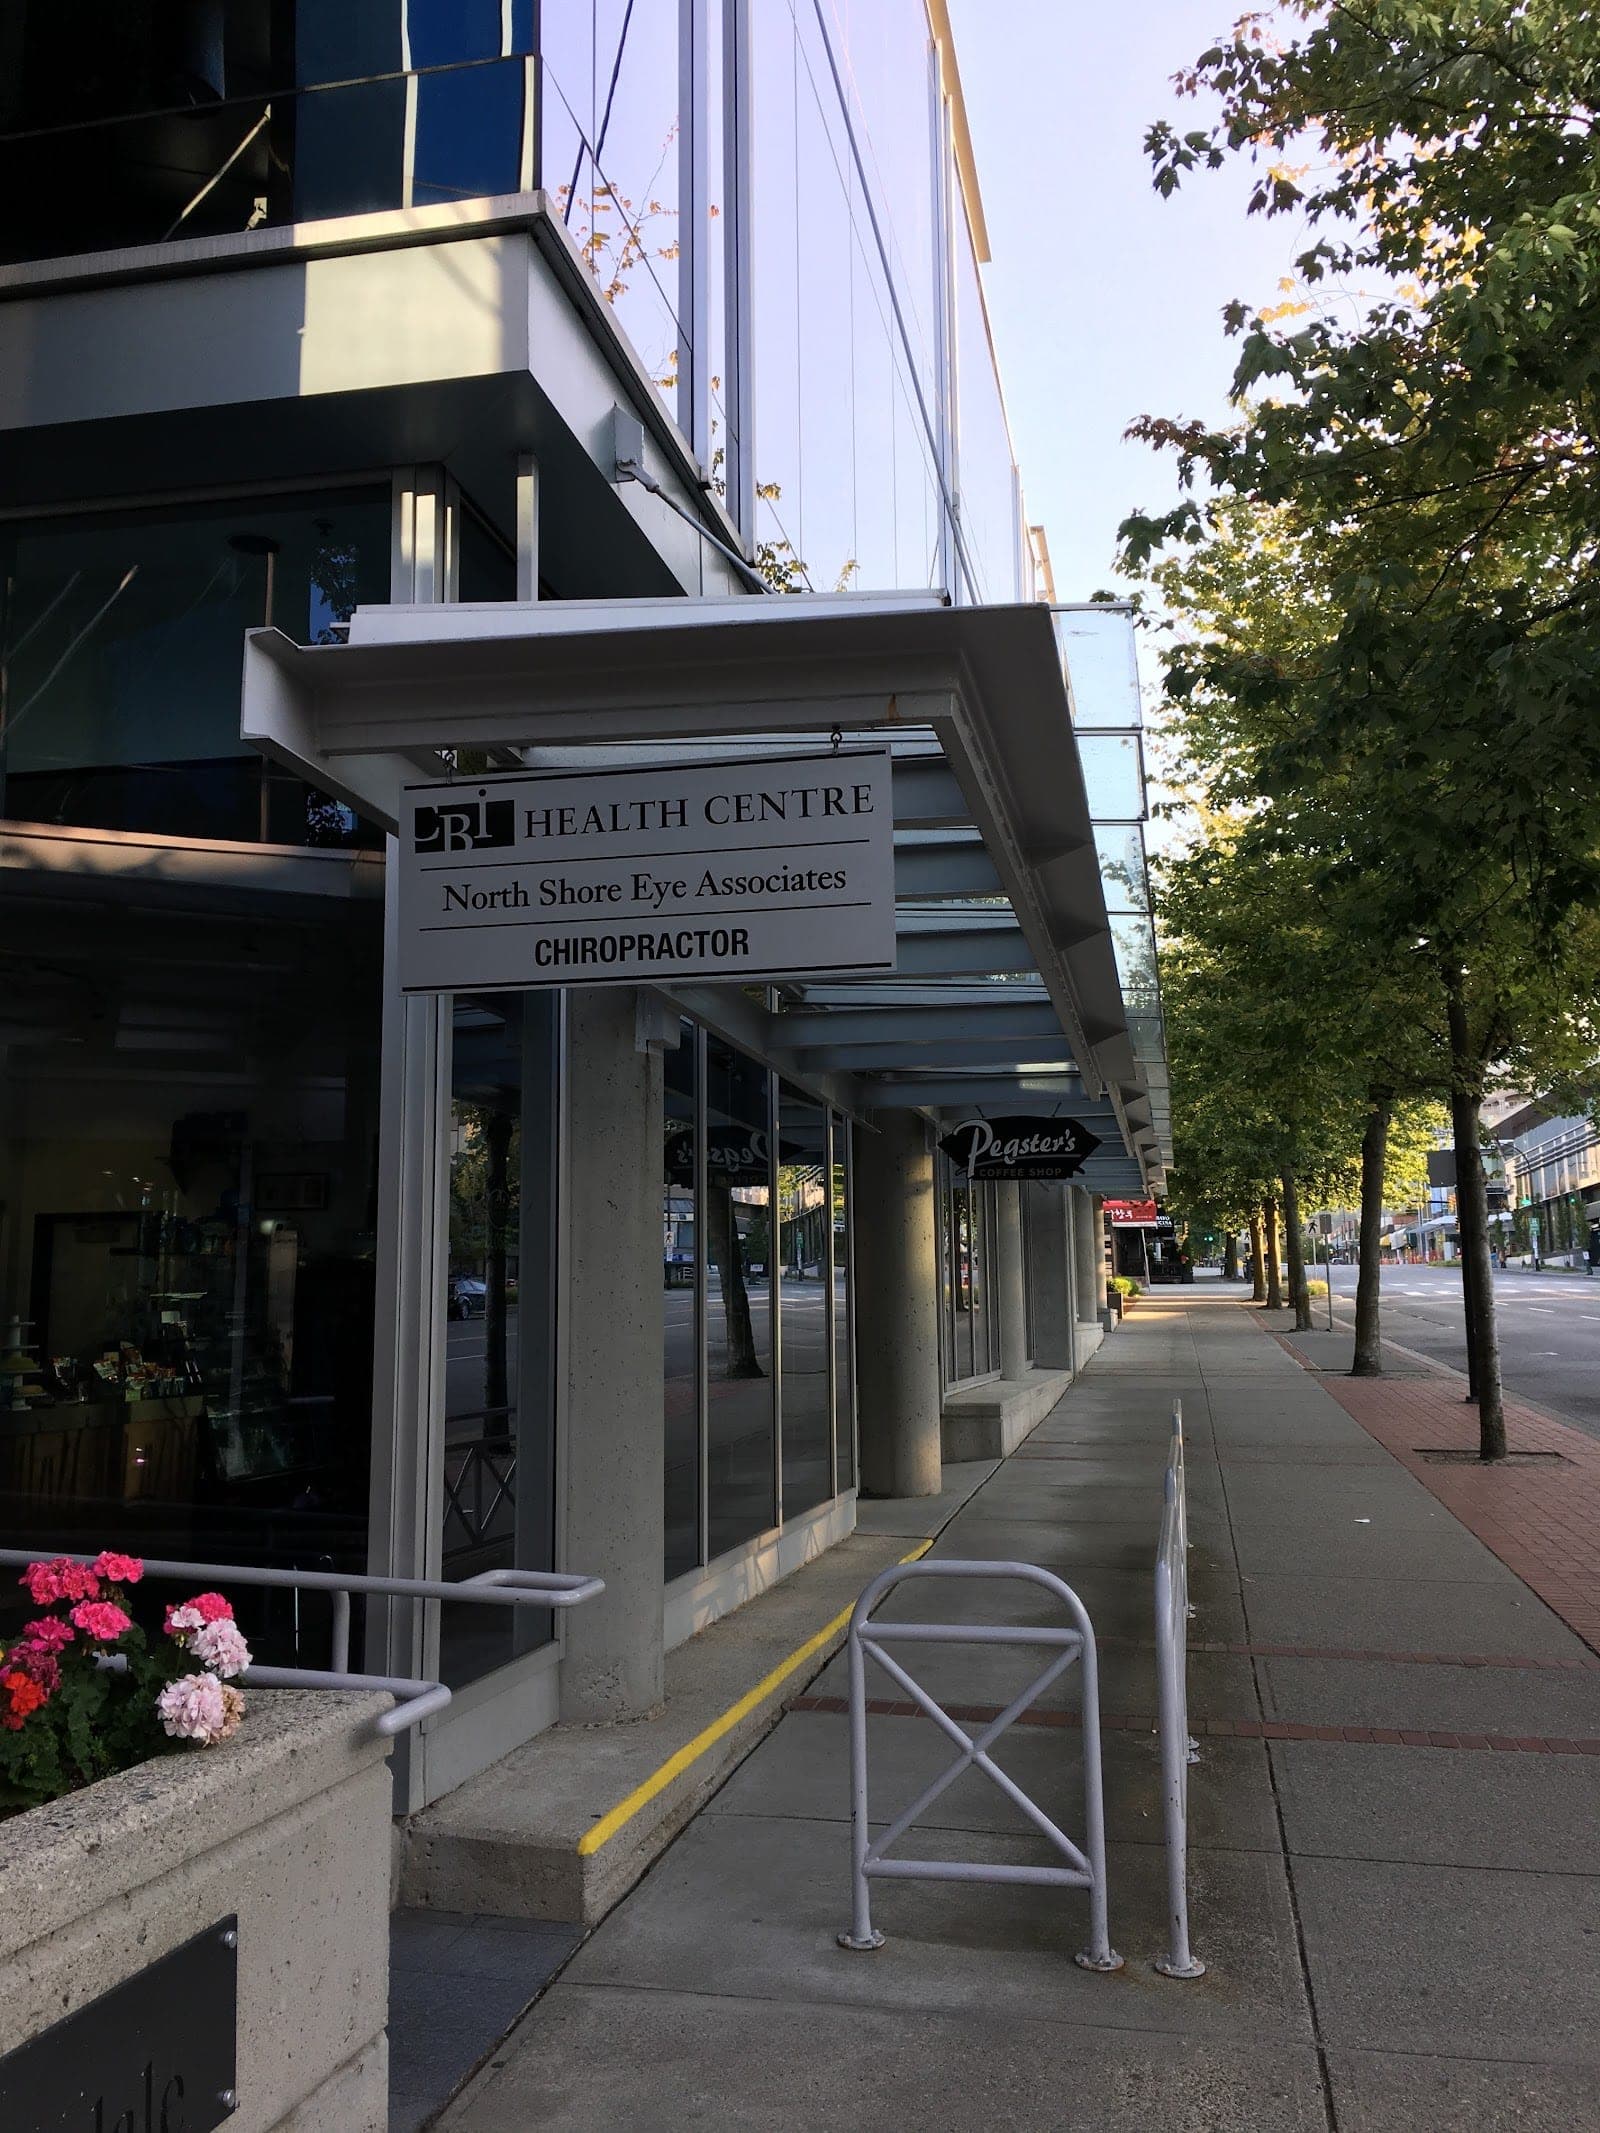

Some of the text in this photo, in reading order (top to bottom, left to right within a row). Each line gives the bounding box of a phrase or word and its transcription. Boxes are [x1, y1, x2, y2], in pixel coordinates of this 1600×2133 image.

[524, 799, 689, 838] HEALTH
[704, 784, 874, 825] CENTRE
[442, 865, 847, 911] North Shore Eye Associates
[535, 928, 750, 966] CHIROPRACTOR
[953, 1119, 1077, 1179] Pegster's
[979, 1167, 1063, 1178] COFFEE SHOP
